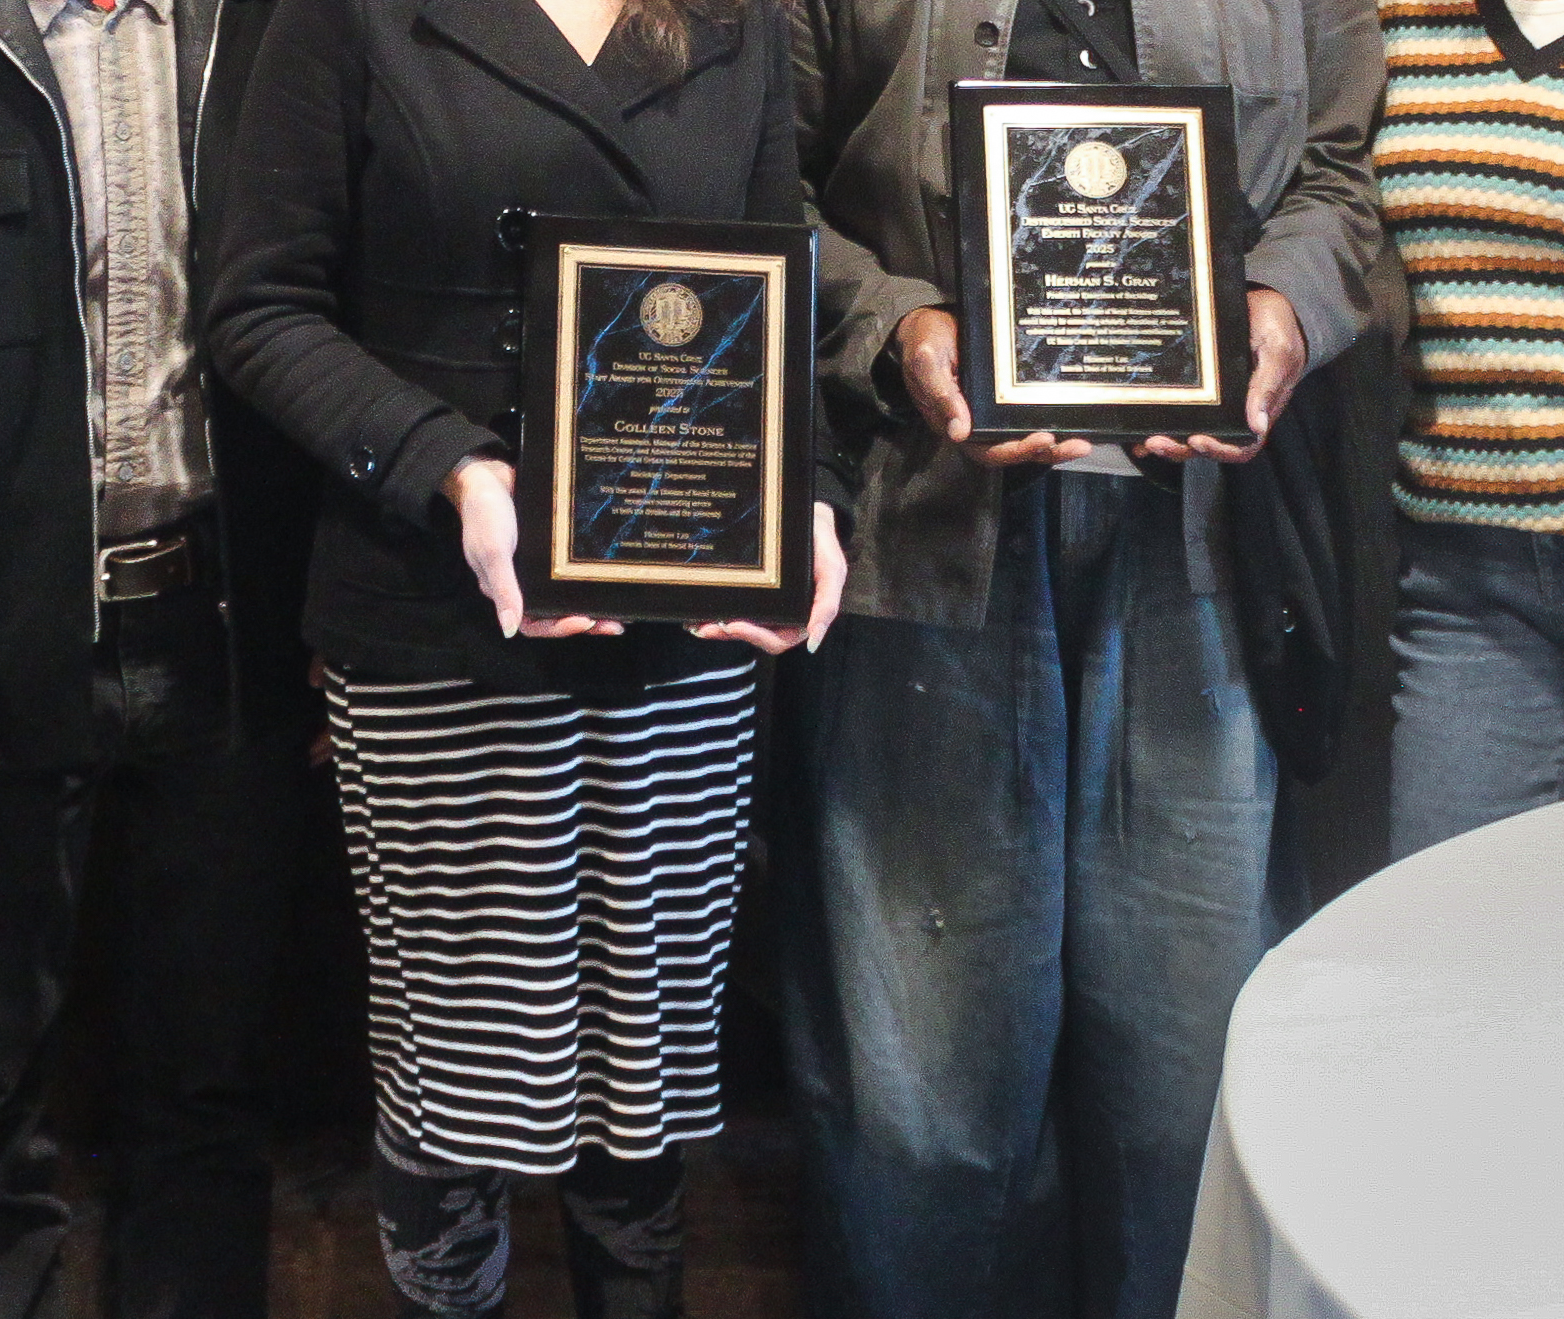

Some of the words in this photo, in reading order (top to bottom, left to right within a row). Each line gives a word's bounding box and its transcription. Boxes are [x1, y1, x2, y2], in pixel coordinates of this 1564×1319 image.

[1058, 203, 1076, 214] UC
[1077, 203, 1109, 214] SANTA
[1045, 273, 1102, 287] HERMAN
[1103, 275, 1118, 287] S.
[1121, 275, 1158, 287] GRAY
[614, 420, 676, 435] COLLEEN
[678, 422, 725, 437] STONE
